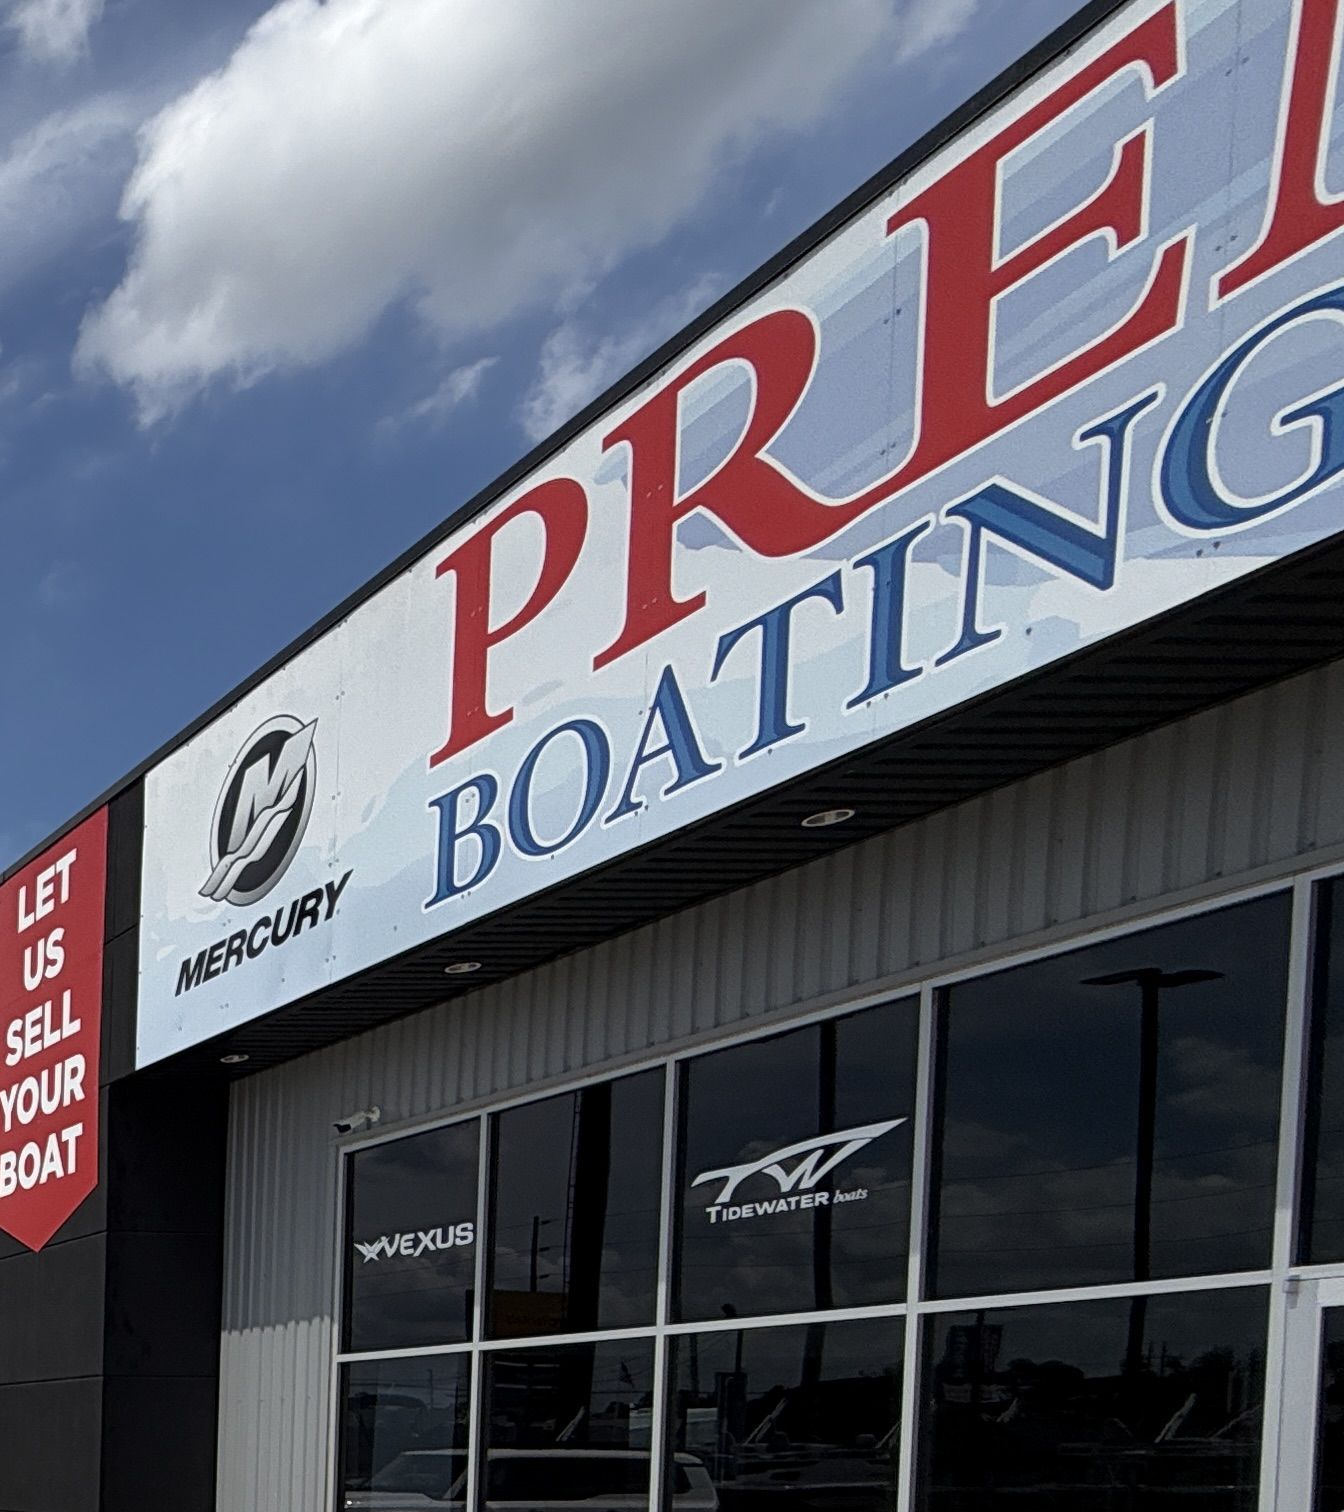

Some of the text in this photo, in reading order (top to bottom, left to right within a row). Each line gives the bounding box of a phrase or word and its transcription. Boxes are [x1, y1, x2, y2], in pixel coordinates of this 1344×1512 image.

[422, 288, 1344, 908] BOATING
[17, 848, 77, 934] LET
[24, 927, 65, 991] US
[174, 870, 353, 998] MERCURY
[5, 989, 81, 1066] SELL
[833, 1188, 869, 1204] boats
[379, 1222, 474, 1258] VEXUS
